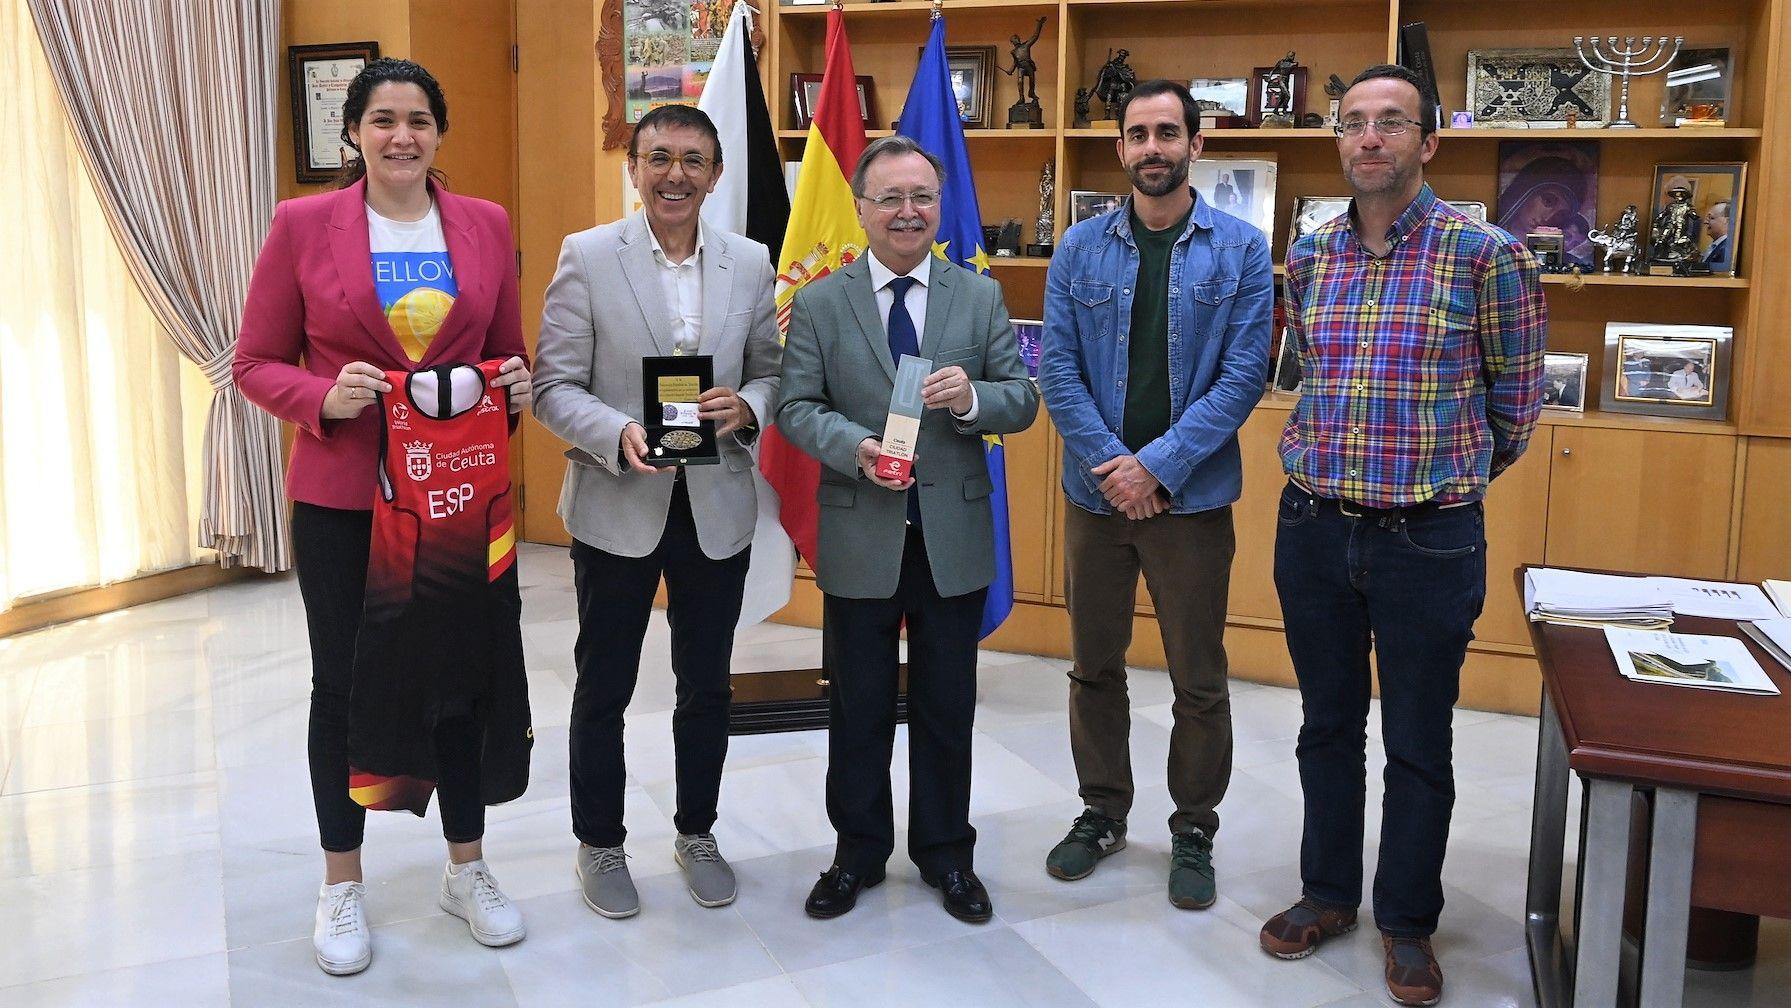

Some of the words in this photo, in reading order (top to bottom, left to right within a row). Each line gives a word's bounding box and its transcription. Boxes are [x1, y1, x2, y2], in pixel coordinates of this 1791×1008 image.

[371, 260, 454, 282] ELLO
[436, 450, 460, 460] Ciudad
[461, 443, 495, 455] Autónoma
[436, 460, 447, 468] de
[450, 451, 496, 472] Ceuta
[428, 483, 474, 519] ESP
